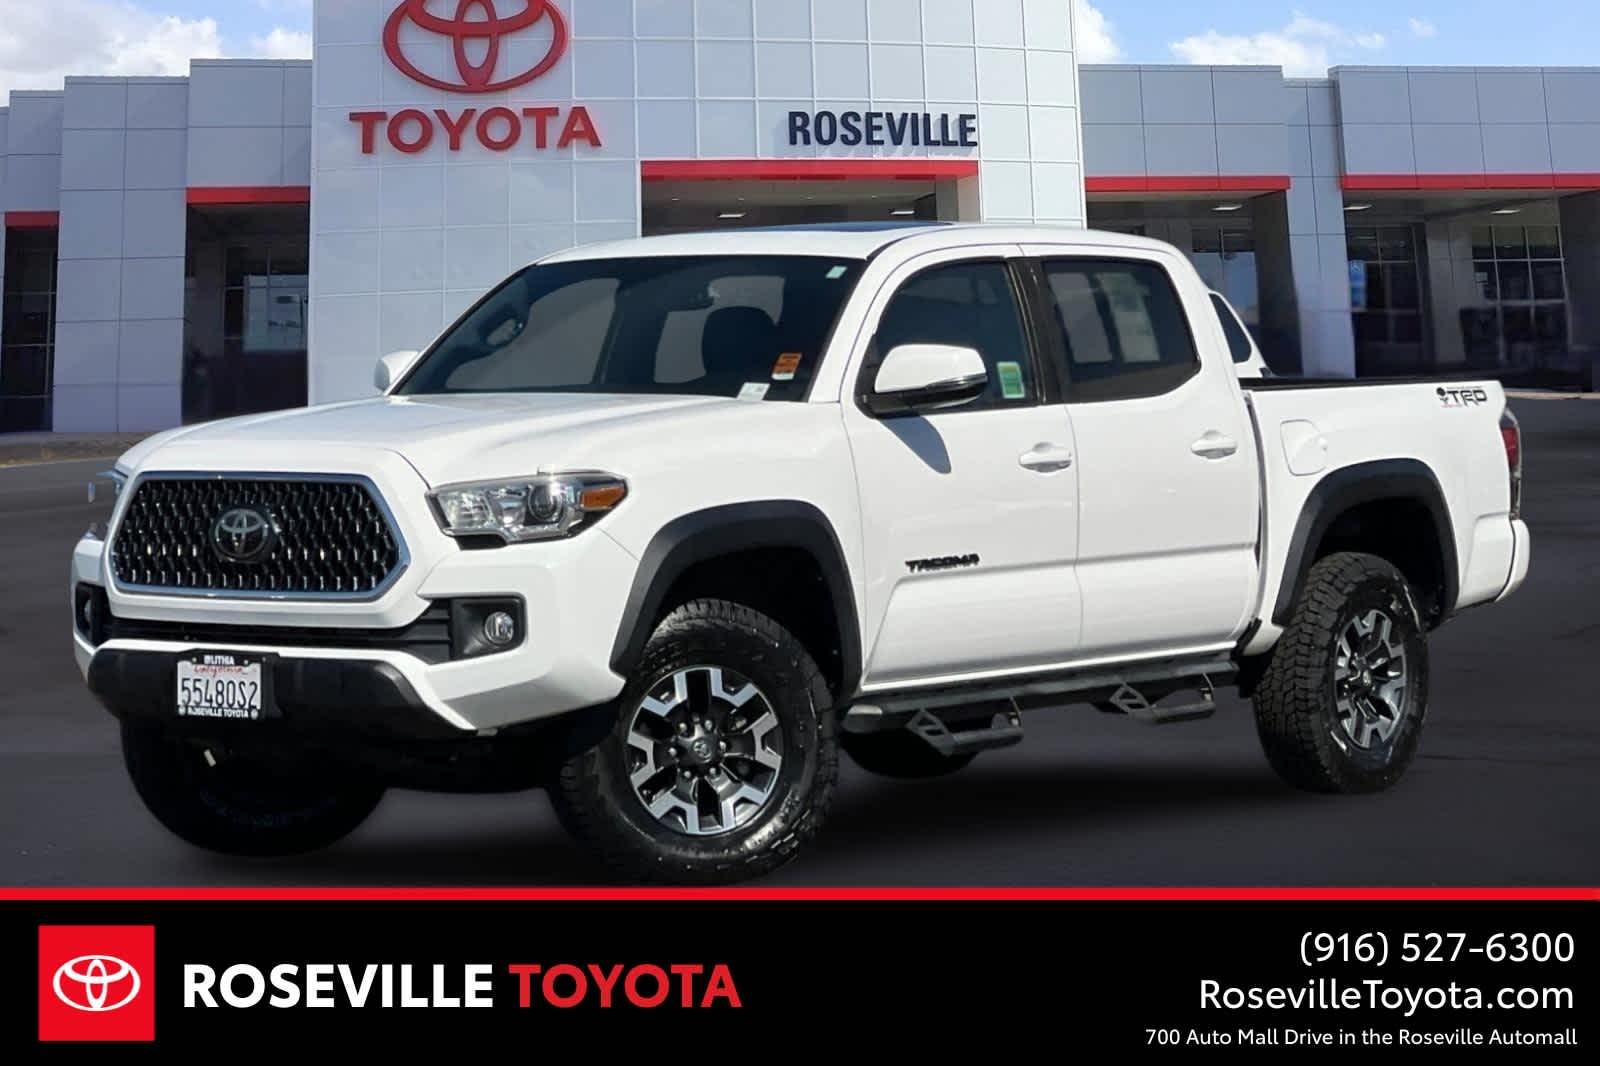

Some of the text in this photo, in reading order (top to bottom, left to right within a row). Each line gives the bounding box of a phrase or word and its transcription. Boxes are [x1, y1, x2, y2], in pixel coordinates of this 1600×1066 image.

[349, 106, 602, 153] TOYOTA
[788, 111, 978, 147] ROSEVILLE
[1446, 390, 1488, 406] TRD
[905, 553, 980, 573] TACOMA
[181, 678, 258, 709] 55480S2
[223, 709, 249, 718] TOYOTA
